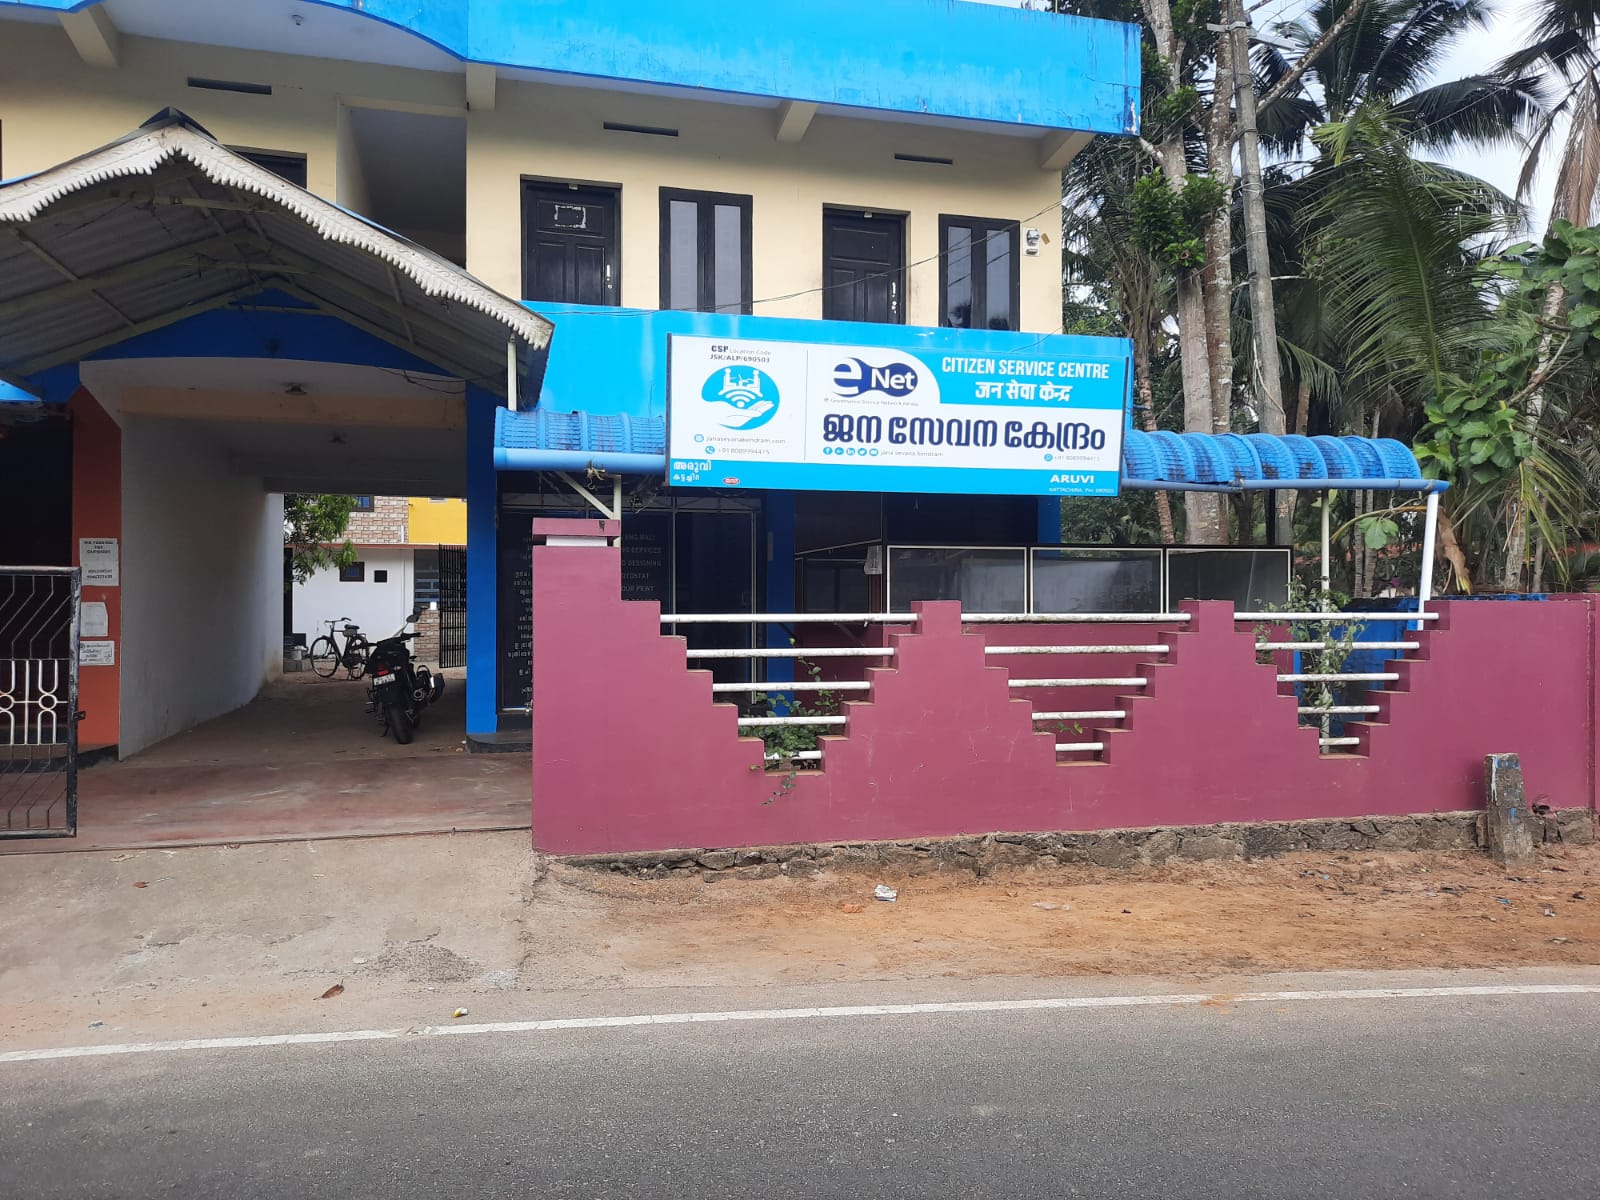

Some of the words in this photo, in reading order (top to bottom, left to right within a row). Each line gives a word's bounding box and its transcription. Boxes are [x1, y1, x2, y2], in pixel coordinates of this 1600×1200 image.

[711, 345, 729, 353] CSP
[941, 357, 995, 375] CITIZEN
[998, 359, 1055, 377] SERVICE
[1058, 361, 1110, 379] CENTRE
[975, 381, 1004, 399] जन
[1005, 379, 1037, 400] सेवा
[1039, 381, 1073, 402] केन्द्र
[823, 413, 882, 443] ജന
[888, 416, 998, 447] സേവന
[1004, 420, 1106, 452] കേന്ദ്രം
[673, 459, 712, 473] അരുവി
[1050, 474, 1095, 484] ARUVI
